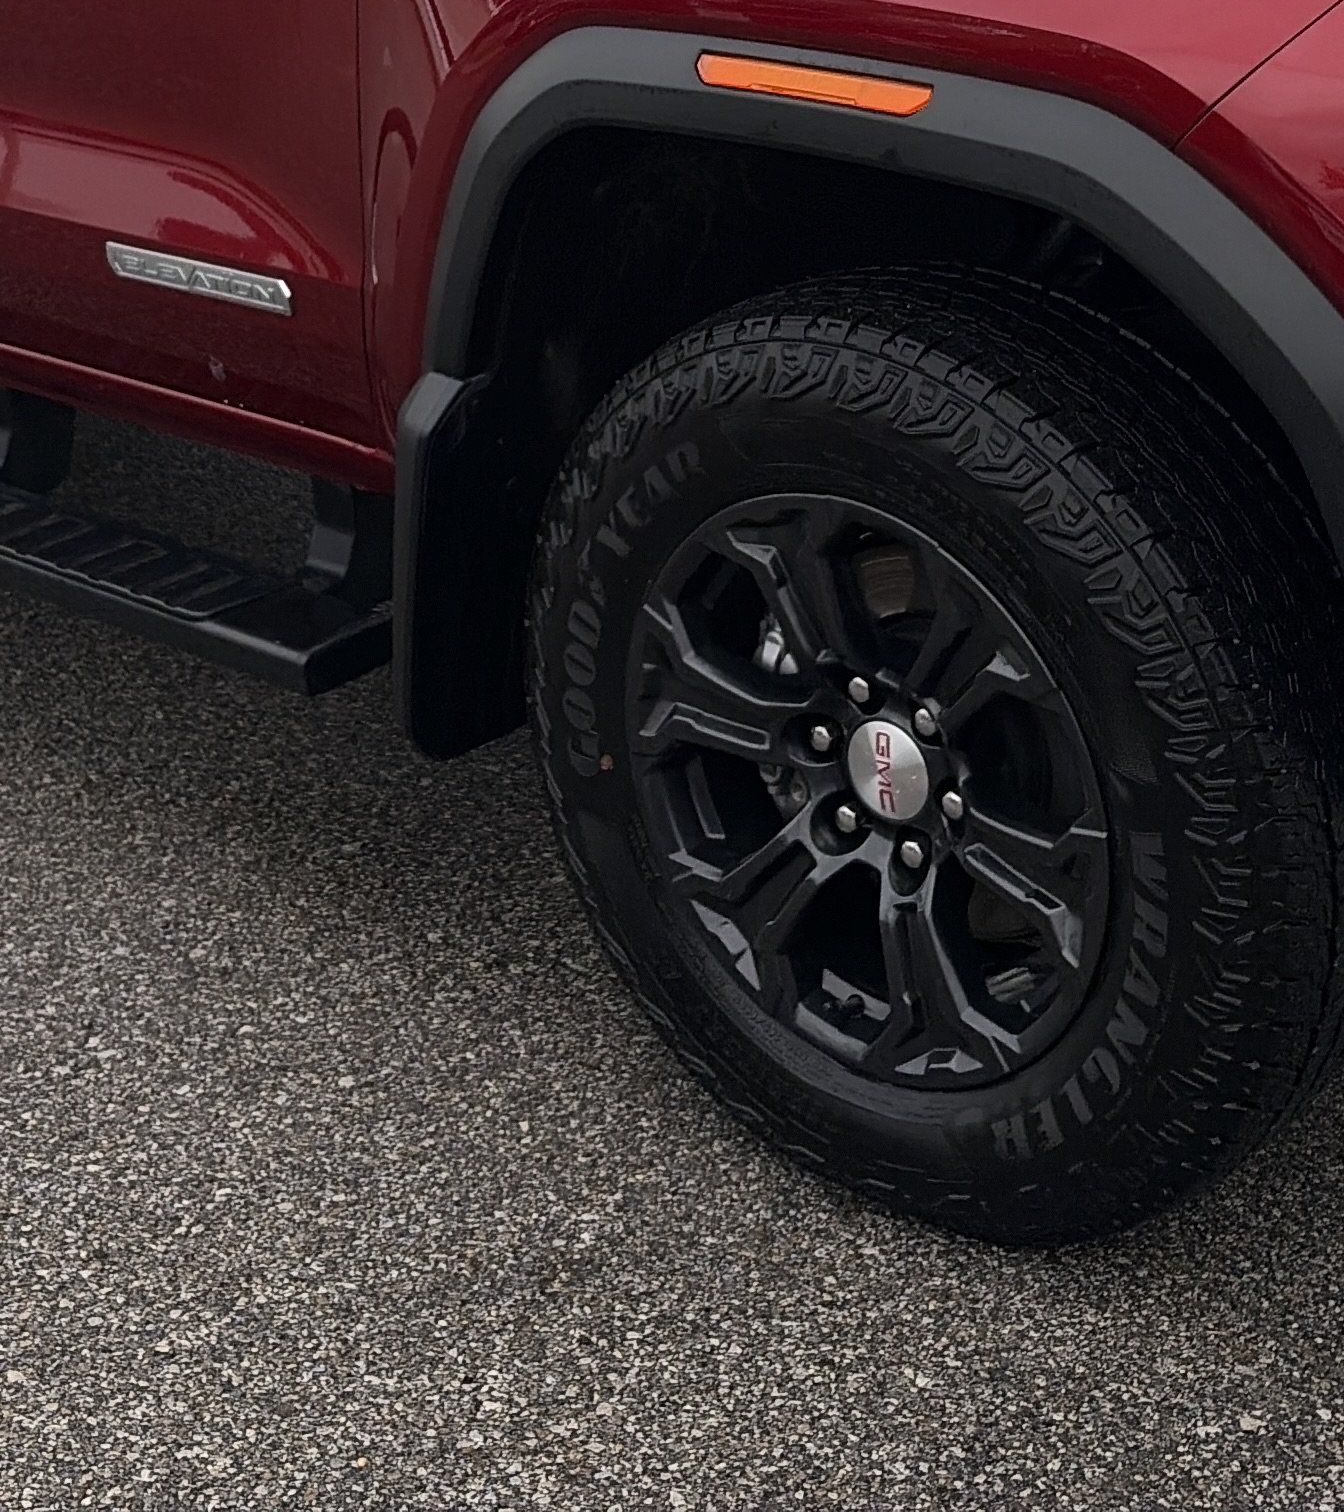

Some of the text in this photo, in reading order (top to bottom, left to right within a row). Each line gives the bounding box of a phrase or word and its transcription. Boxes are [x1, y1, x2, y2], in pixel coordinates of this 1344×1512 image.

[120, 252, 277, 301] ELEVATION
[875, 731, 896, 814] GMC
[991, 830, 1170, 1162] WRANGLER
